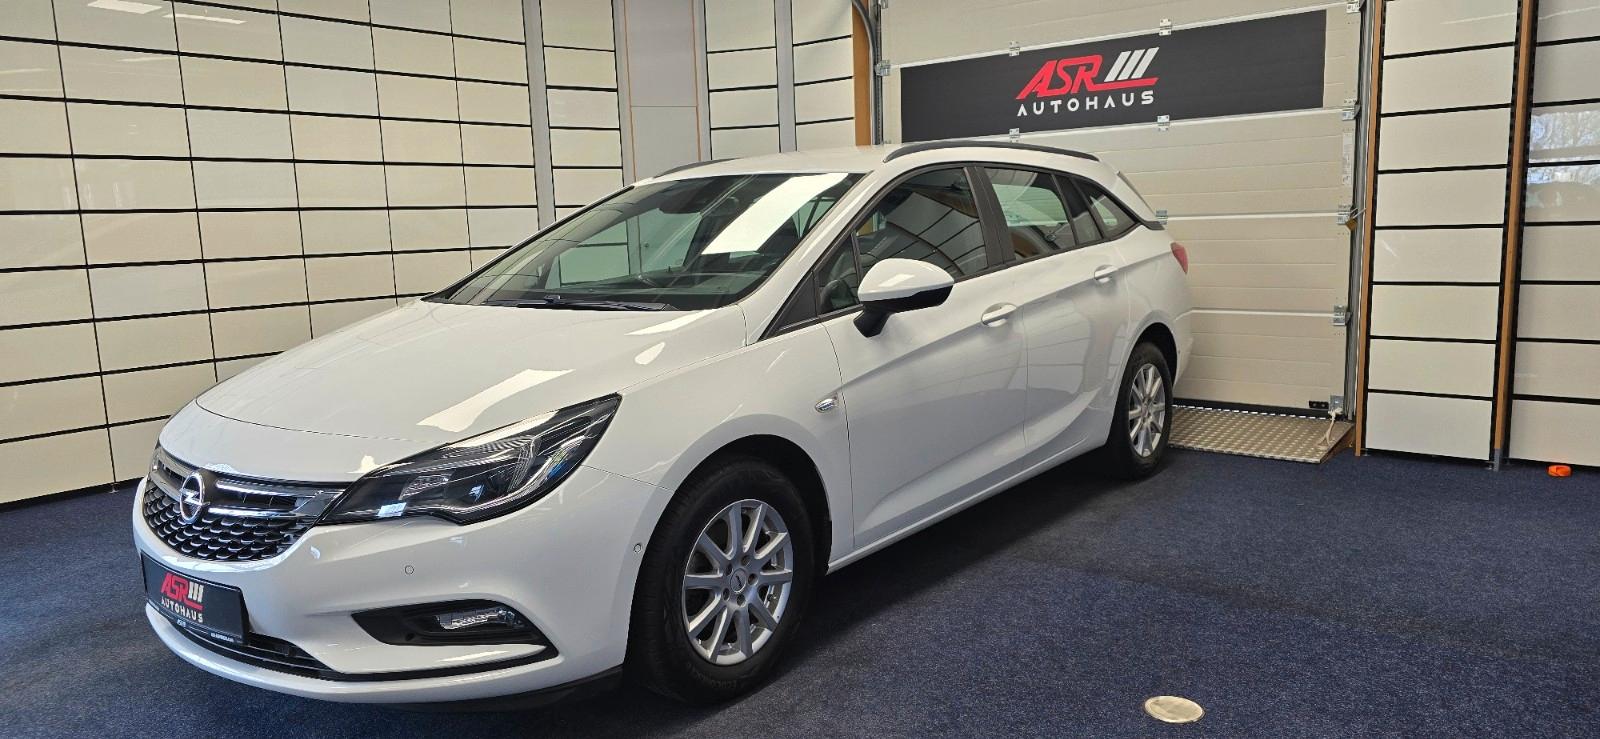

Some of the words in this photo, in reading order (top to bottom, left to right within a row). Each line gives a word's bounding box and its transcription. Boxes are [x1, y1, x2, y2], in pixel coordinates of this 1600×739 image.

[1016, 54, 1107, 99] ASR
[1017, 90, 1154, 117] AUTOHAUS
[161, 572, 190, 603] ASR
[161, 596, 204, 623] AUTOHAUS
